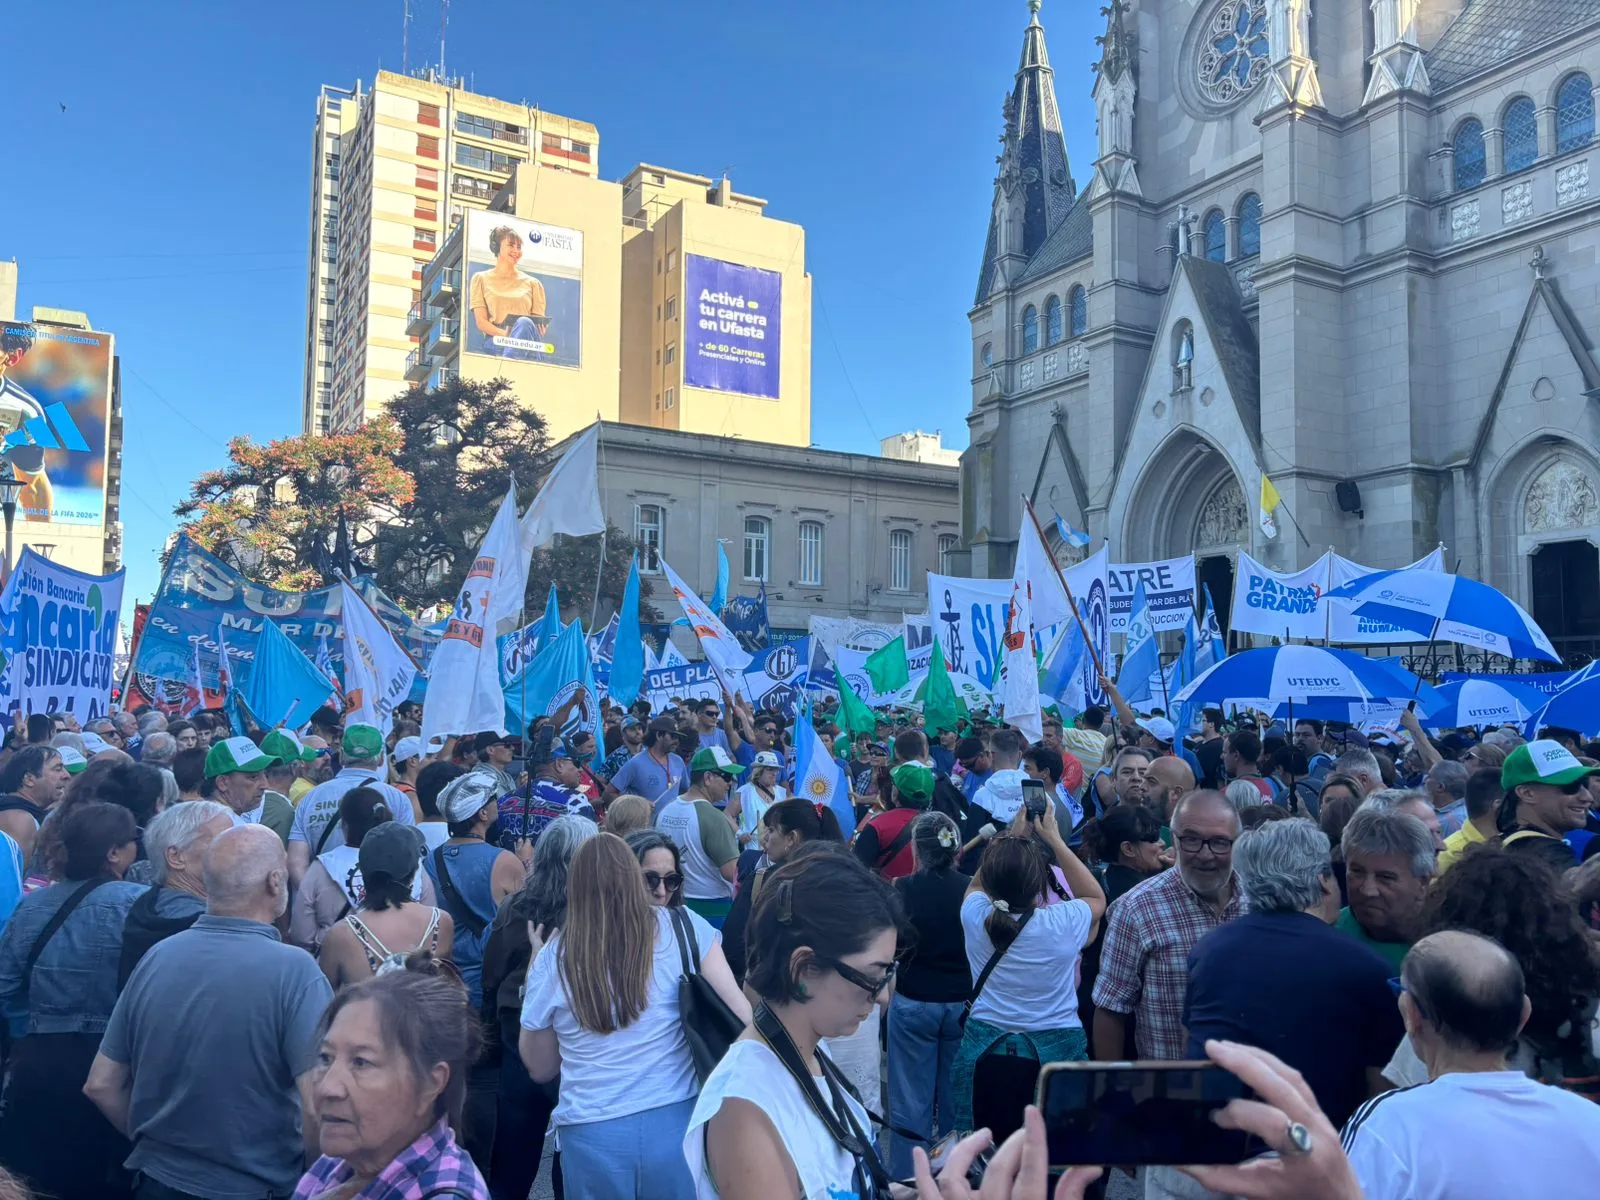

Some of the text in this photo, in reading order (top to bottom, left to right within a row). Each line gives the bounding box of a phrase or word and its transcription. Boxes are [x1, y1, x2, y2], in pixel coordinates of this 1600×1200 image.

[545, 237, 573, 251] FASTA
[699, 289, 745, 309] Activá
[699, 303, 767, 327] tu carrera
[699, 318, 765, 340] en Ufasta
[496, 337, 542, 350] ufasta.edu.ar
[705, 342, 717, 352] de
[718, 343, 729, 353] 60
[730, 344, 765, 359] Carreras
[698, 349, 739, 363] Presenciales
[744, 356, 767, 367] Online
[51, 509, 59, 517] LA
[60, 510, 75, 518] FIFA
[46, 576, 86, 605] Bancaria
[1248, 574, 1317, 600] PATRIA
[1147, 598, 1164, 606] MAR
[1164, 596, 1178, 606] DEL
[1178, 594, 1192, 604] PLA
[1246, 591, 1318, 614] GRANDE
[151, 616, 179, 634] en
[24, 647, 112, 691] SINDICATO
[649, 664, 717, 689] DEL PLA
[1287, 677, 1341, 687] UTEDYC
[1468, 706, 1510, 717] UTEDYC
